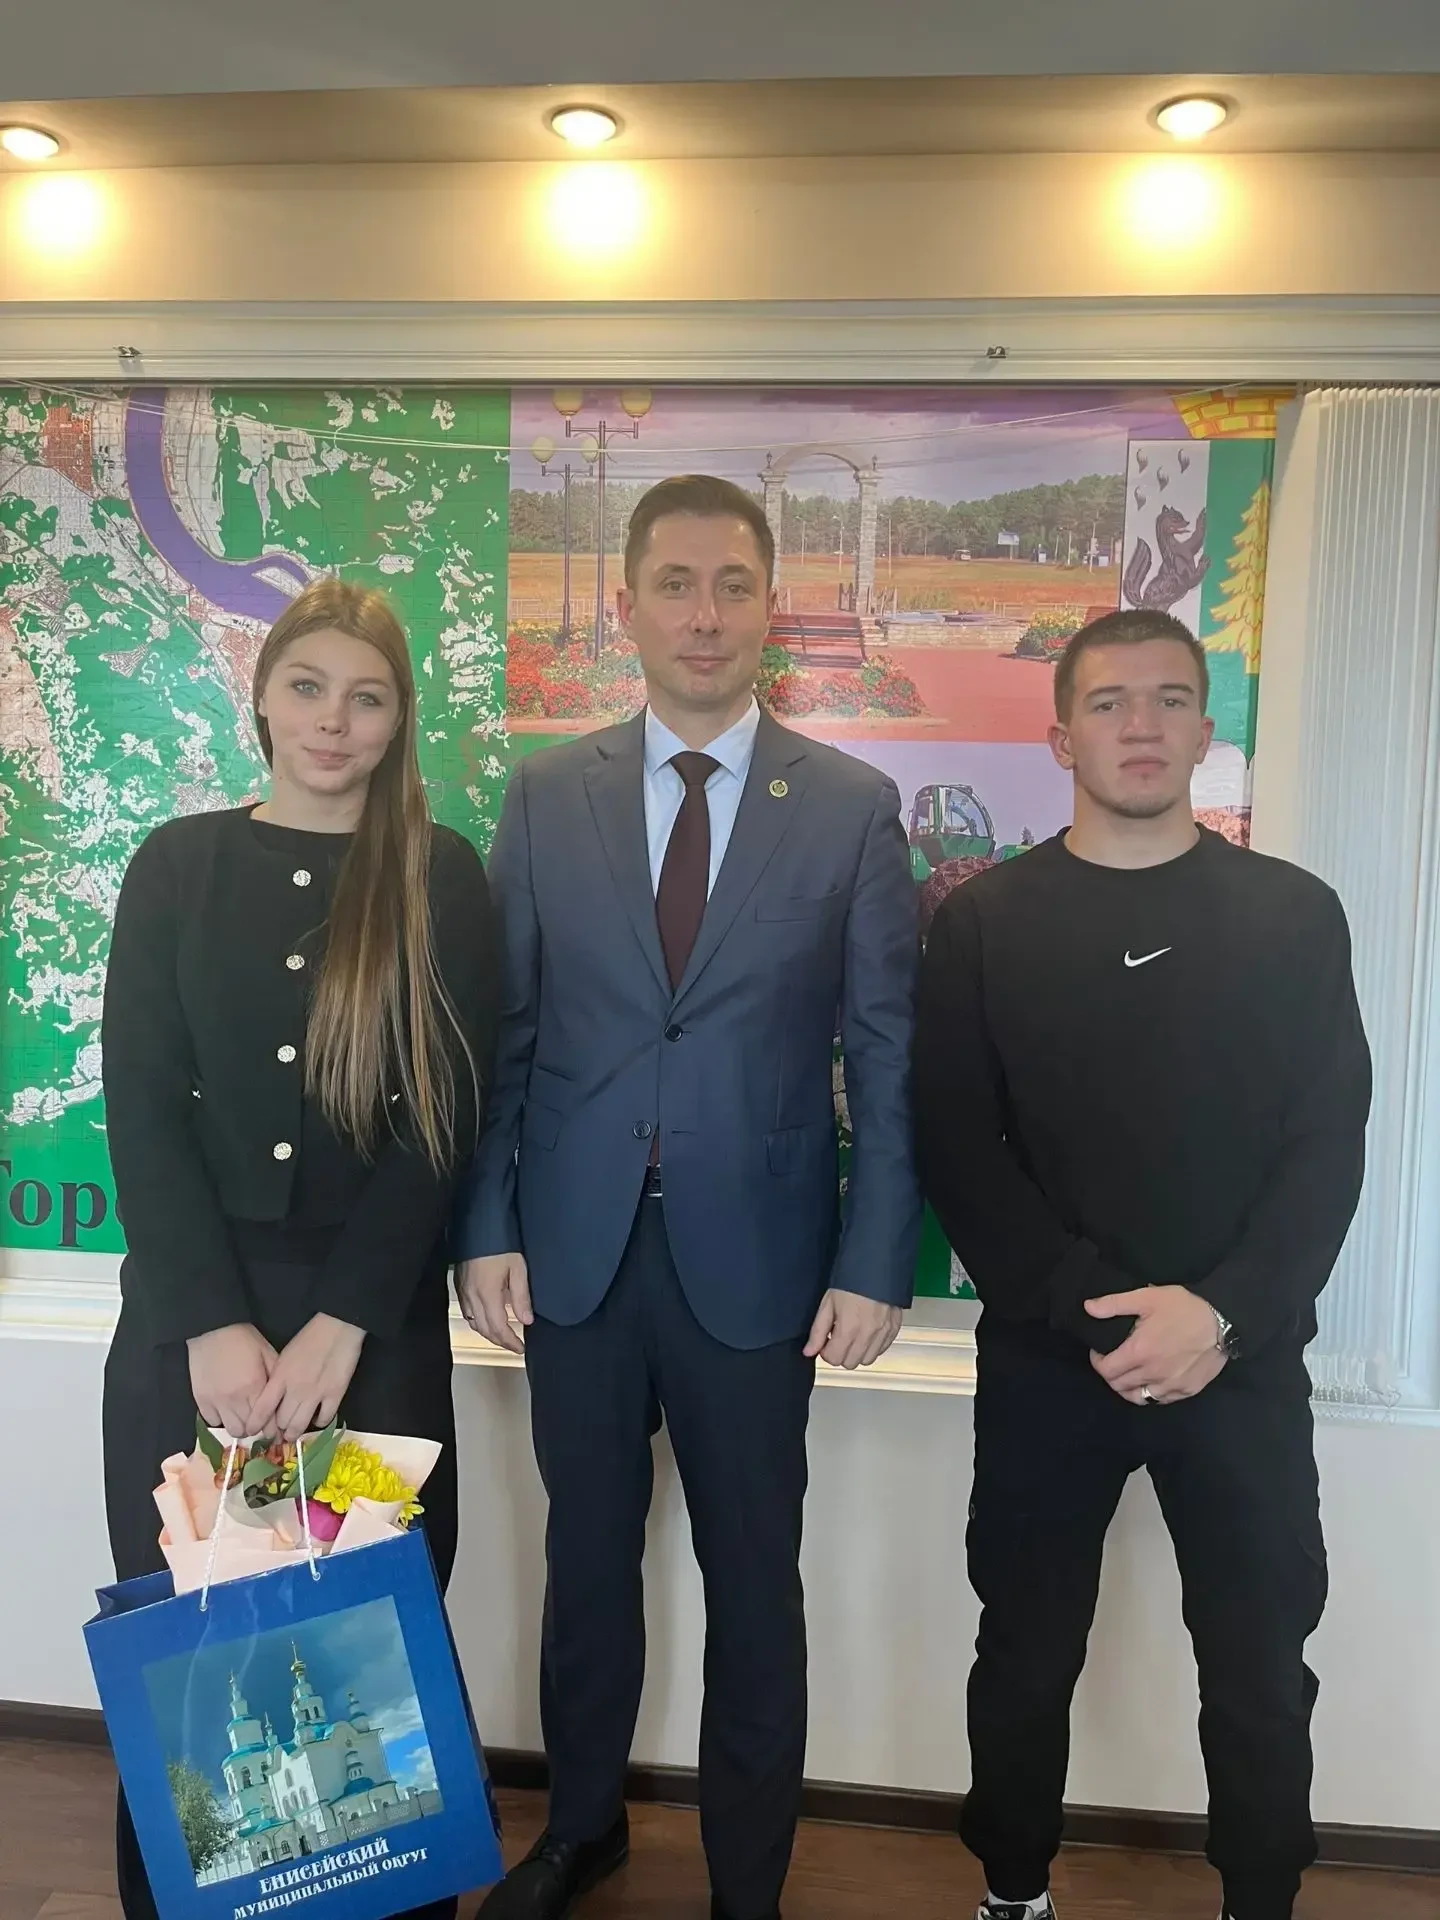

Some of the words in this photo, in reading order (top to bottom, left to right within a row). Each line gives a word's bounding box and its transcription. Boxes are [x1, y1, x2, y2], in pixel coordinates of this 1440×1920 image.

[233, 1862, 380, 1920] МУНИЦИПАЛЬНЫЙ
[382, 1848, 428, 1872] ОКРУГ
[259, 1837, 390, 1894] ЕНИСЕЙСКИЙ
